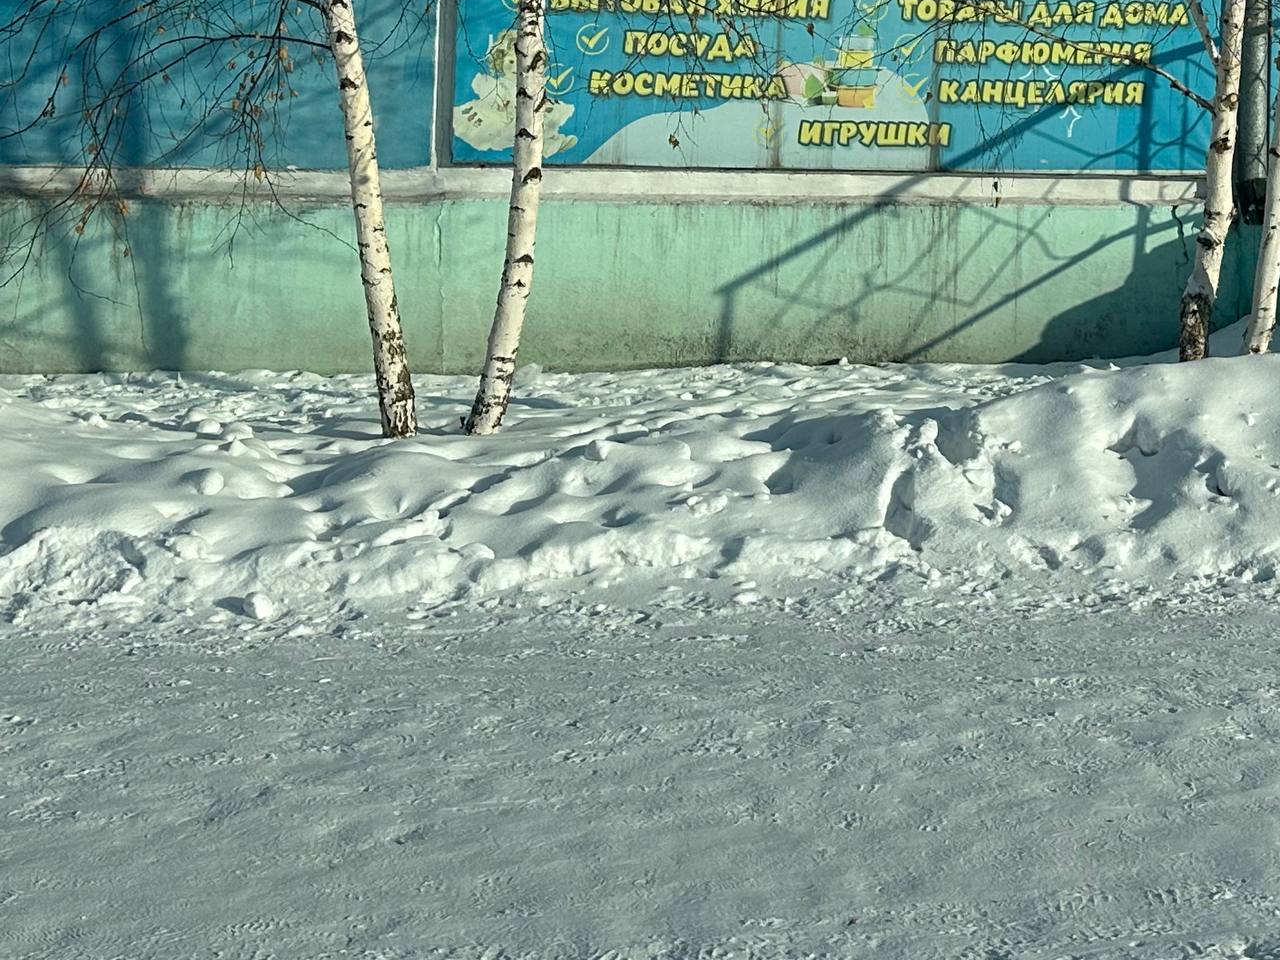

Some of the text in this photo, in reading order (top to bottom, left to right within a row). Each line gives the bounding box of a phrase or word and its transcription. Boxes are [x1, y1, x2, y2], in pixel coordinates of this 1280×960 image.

[1028, 0, 1096, 27] ДЛЯ
[1099, 1, 1191, 30] ДОМА
[624, 29, 758, 61] ПОСУДА
[933, 39, 1153, 66] ПАРФЮМЕРИЯ
[588, 69, 788, 99] КОСМЕТИКА
[938, 78, 1146, 108] КАНЦЕЛЯРИЯ
[798, 119, 952, 147] ИГРУШКИ
